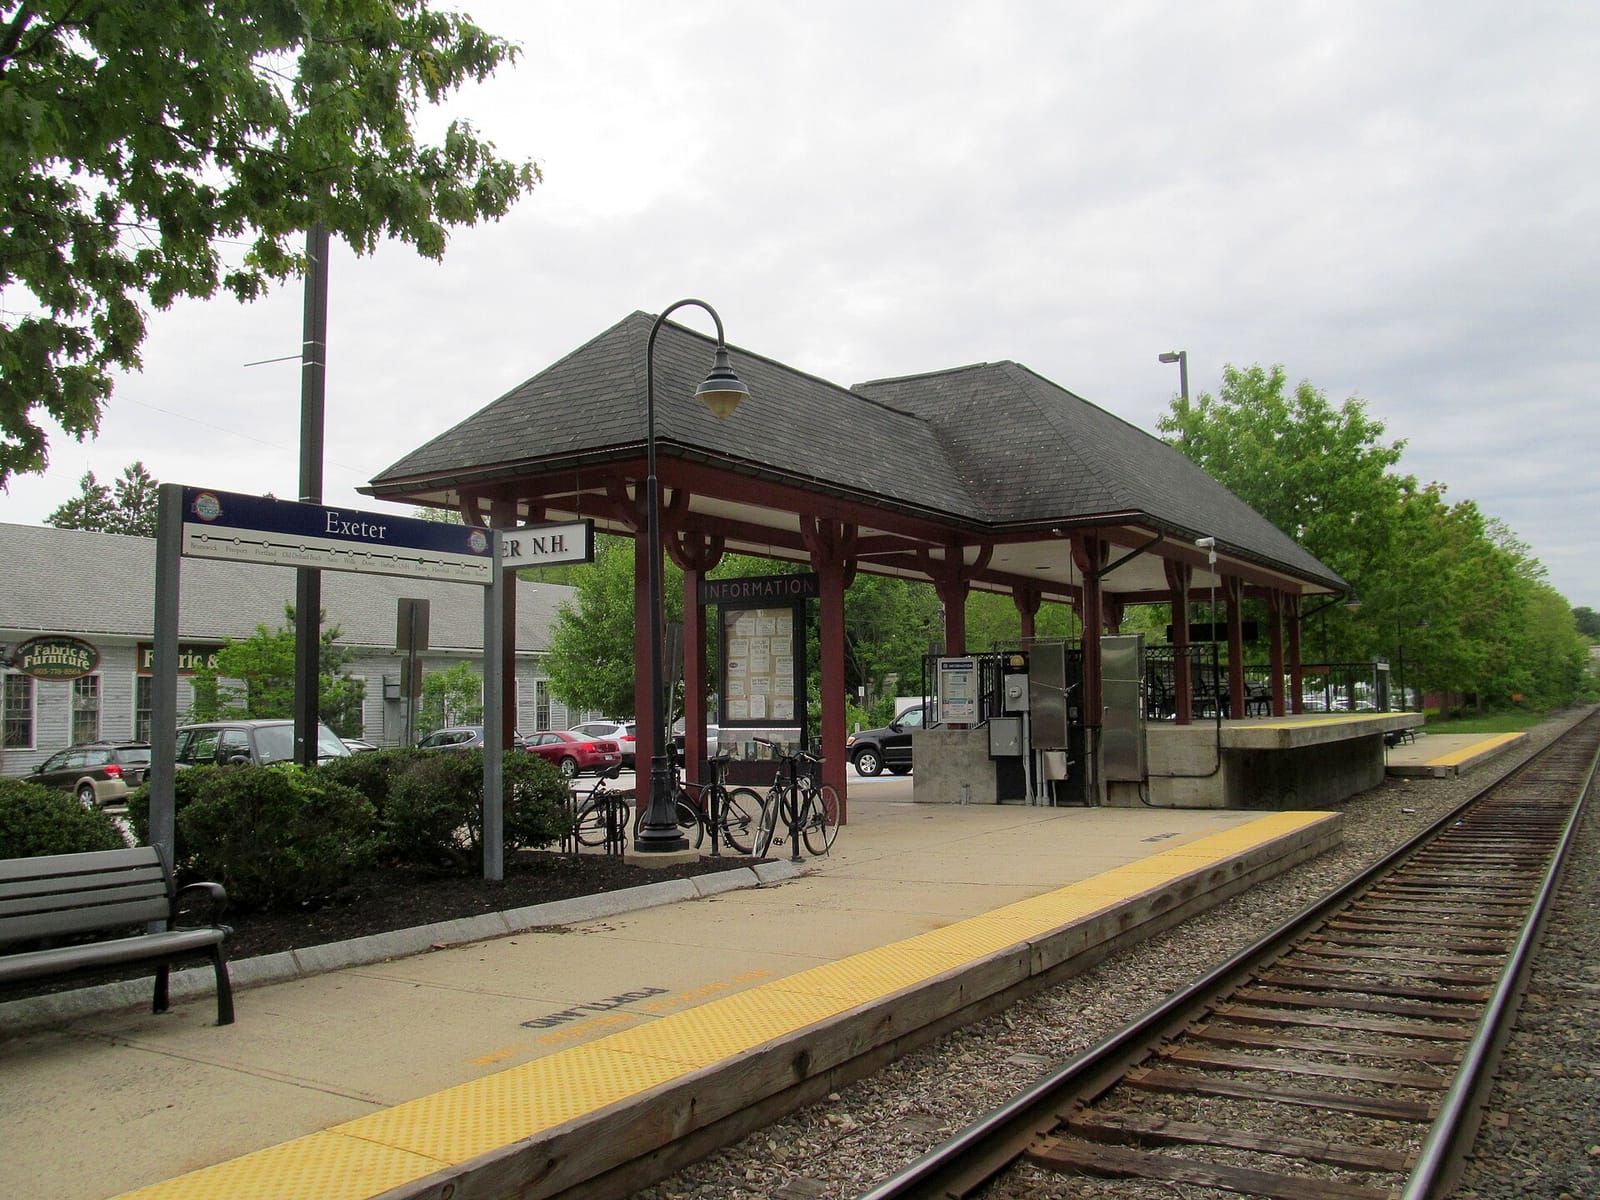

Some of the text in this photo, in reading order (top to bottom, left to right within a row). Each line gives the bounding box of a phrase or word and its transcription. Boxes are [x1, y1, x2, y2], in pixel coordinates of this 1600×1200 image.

[325, 511, 387, 539] Exeter
[704, 579, 814, 599] INFORMATION
[34, 644, 78, 657] Fabric
[79, 650, 88, 659] &
[144, 649, 202, 668] Fric
[23, 654, 90, 670] Furniture
